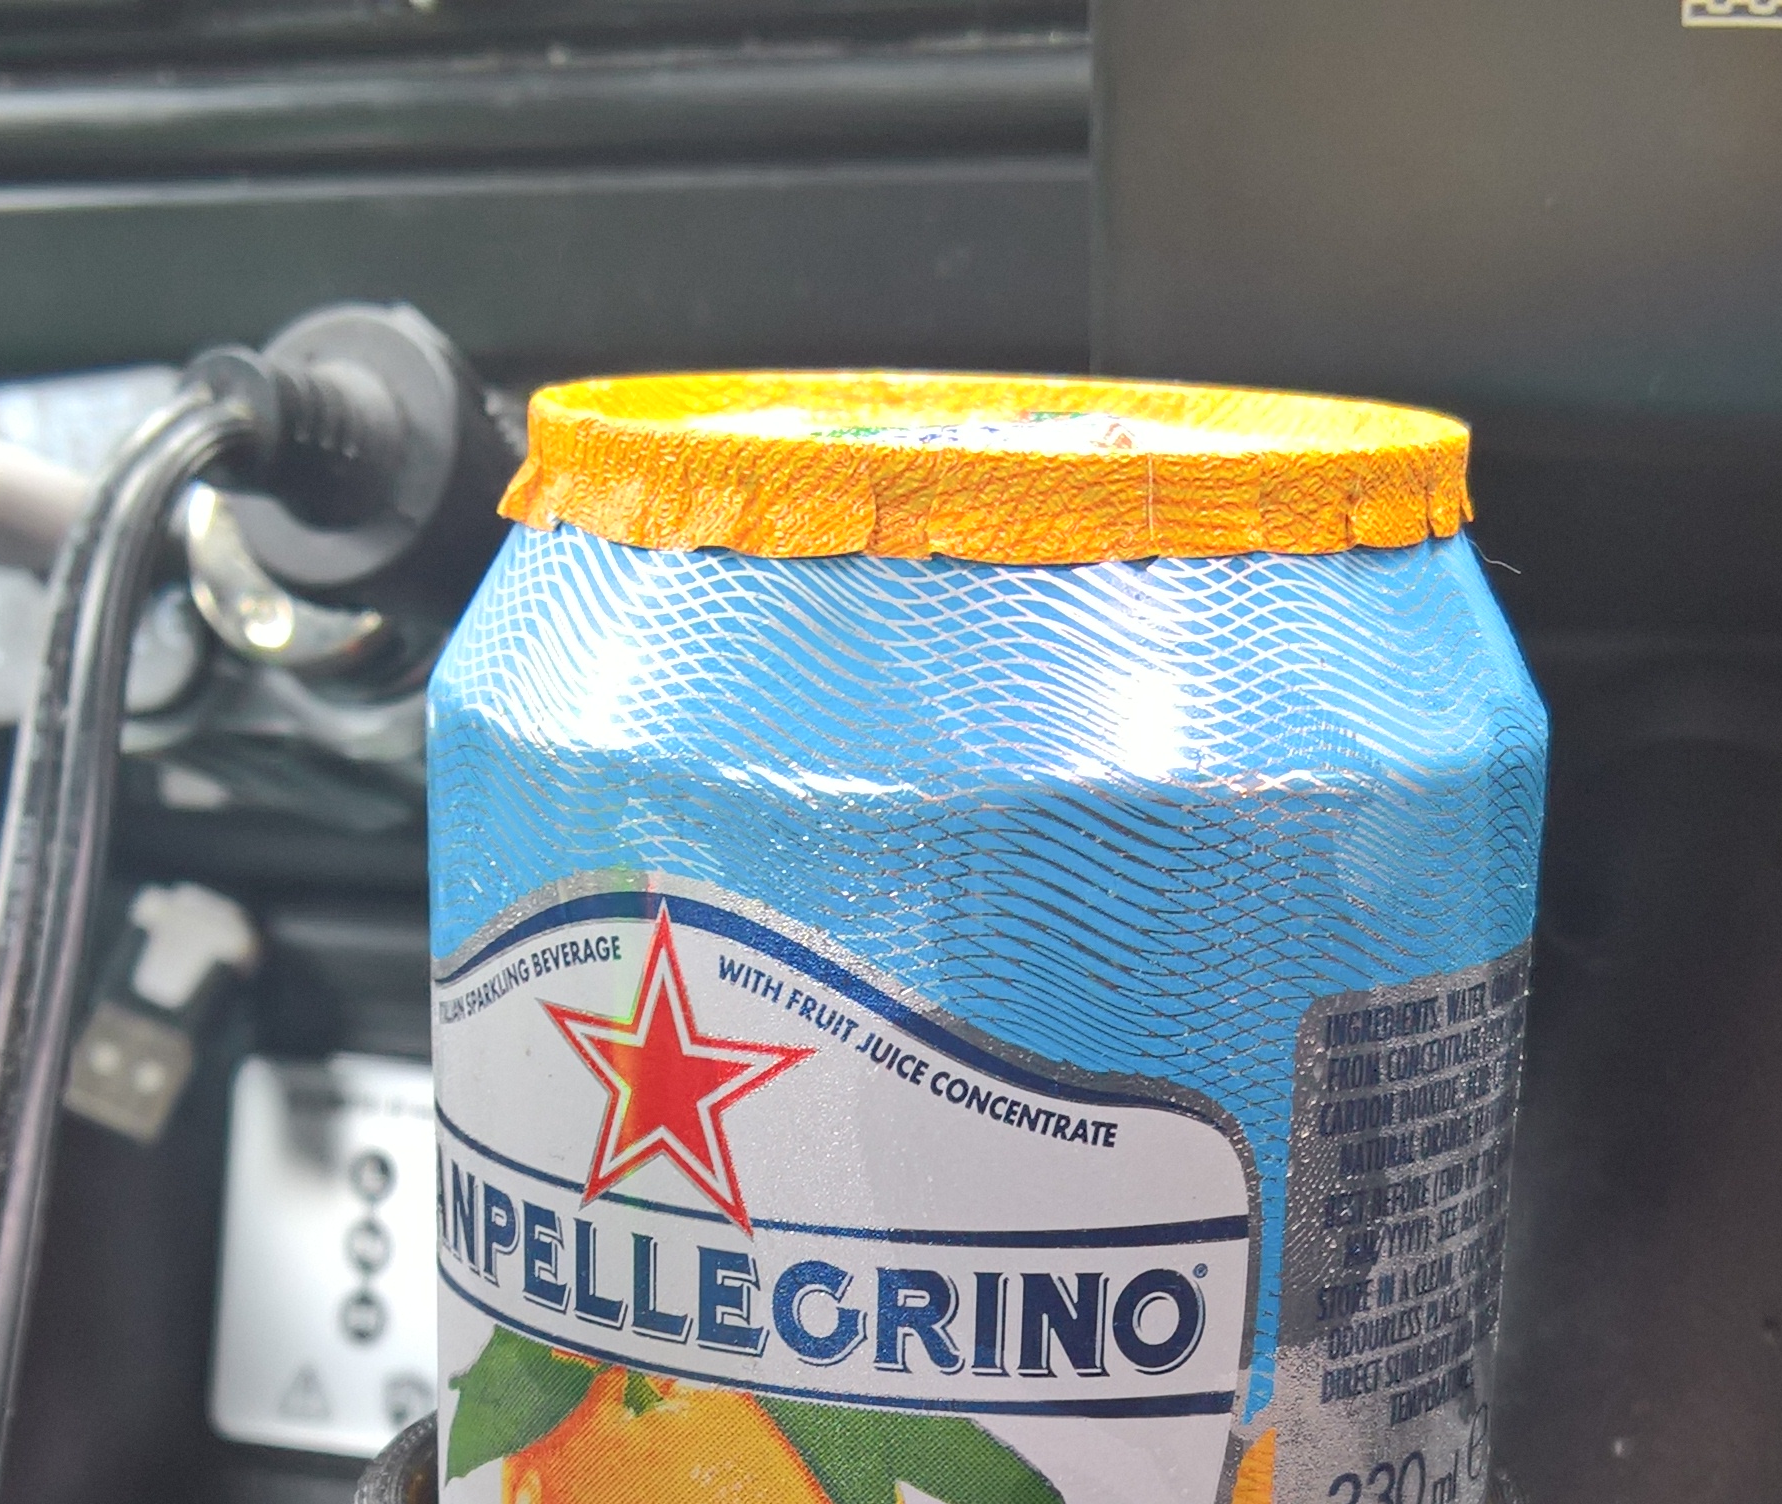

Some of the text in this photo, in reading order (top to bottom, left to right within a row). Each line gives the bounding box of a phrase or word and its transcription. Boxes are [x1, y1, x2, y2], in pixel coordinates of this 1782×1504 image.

[465, 958, 529, 1016] SPARKLING
[531, 935, 622, 978] BEVERAGE
[719, 955, 781, 999] WITH
[785, 986, 859, 1043] FRUIT
[856, 1034, 929, 1085] JUICE
[929, 1070, 1119, 1149] CONCENTRATE
[1327, 1054, 1381, 1094] FROM
[1318, 1092, 1394, 1137] CARBON
[1318, 1279, 1373, 1322] STORE
[1399, 1269, 1410, 1300] A
[1329, 1304, 1421, 1360] ODOURLESS
[1320, 1359, 1381, 1405] DIRECT
